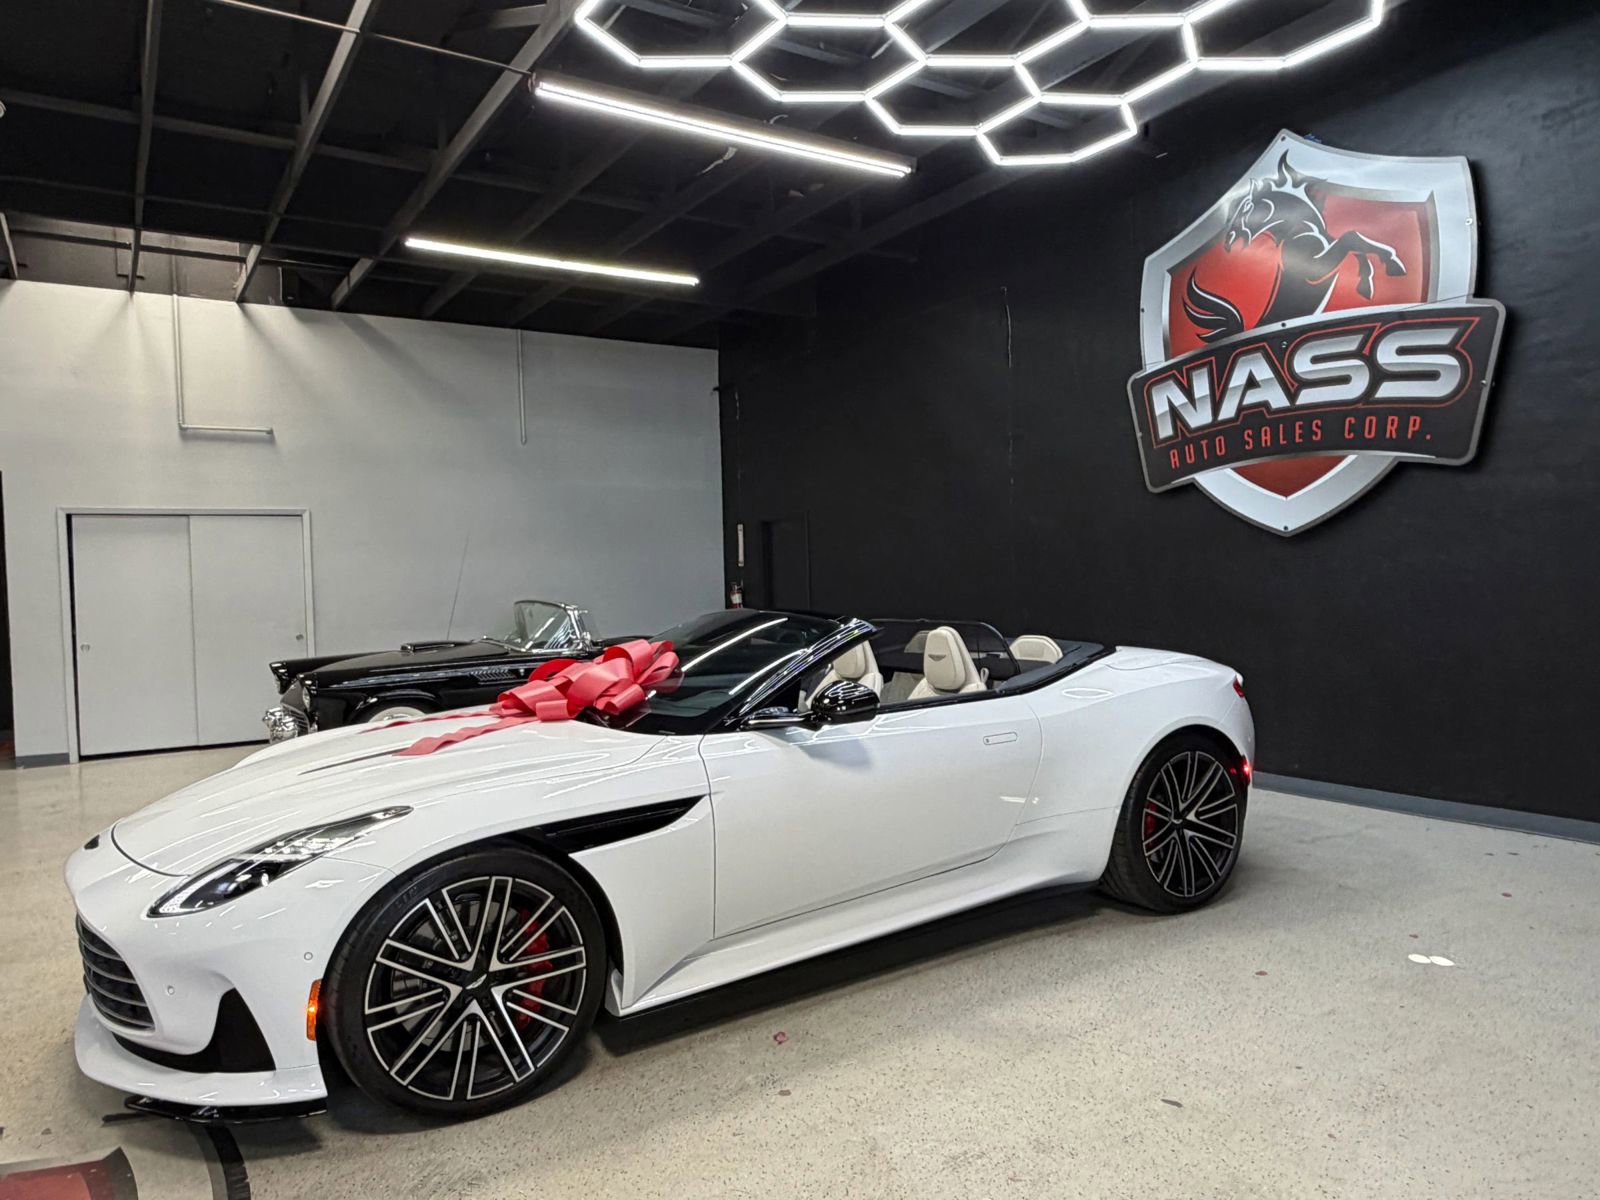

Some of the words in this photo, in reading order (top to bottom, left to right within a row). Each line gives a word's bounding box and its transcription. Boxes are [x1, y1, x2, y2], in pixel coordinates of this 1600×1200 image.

[1149, 328, 1462, 439] NASS
[1169, 435, 1227, 469] AUTO
[1244, 419, 1323, 450] SALES
[1344, 416, 1433, 440] CORP.
